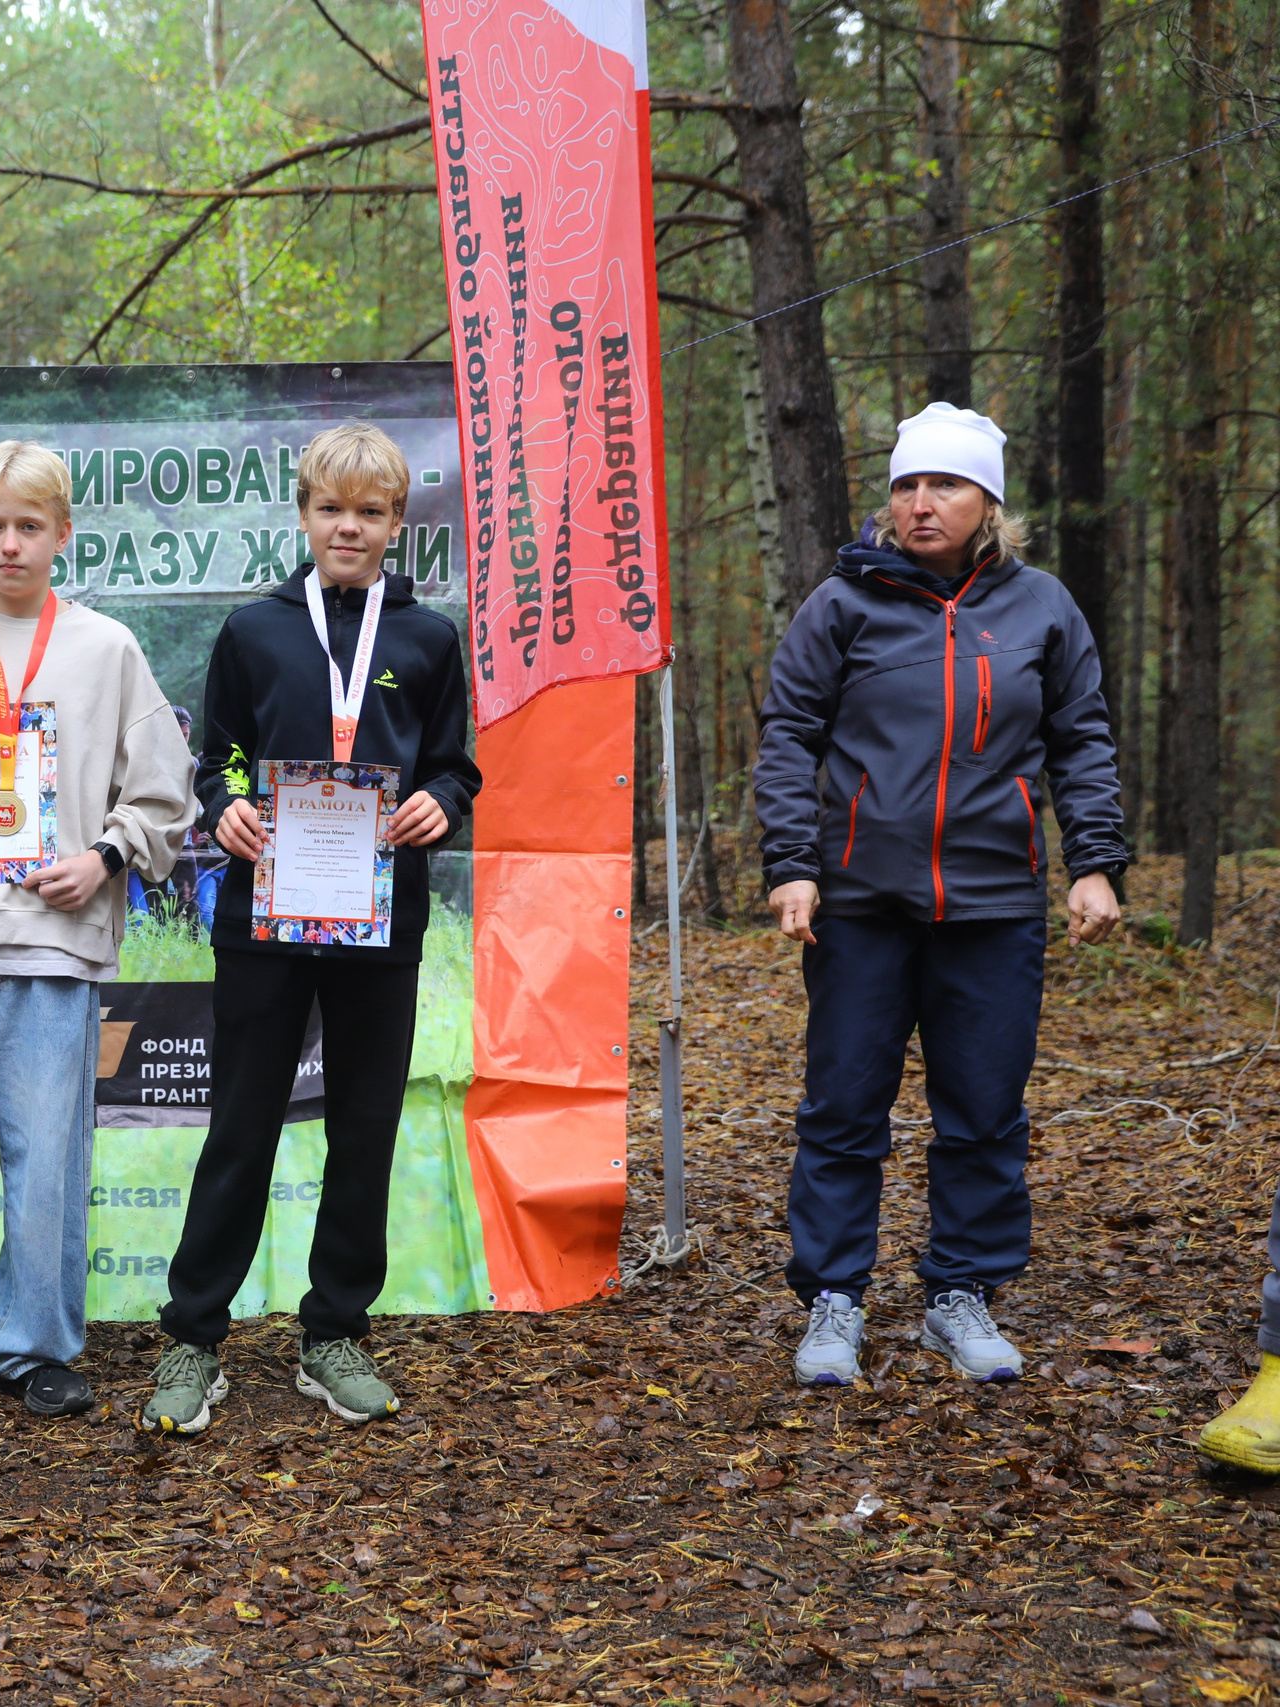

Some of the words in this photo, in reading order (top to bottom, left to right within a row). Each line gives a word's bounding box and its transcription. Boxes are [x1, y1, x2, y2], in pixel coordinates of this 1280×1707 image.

[50, 529, 220, 589] РАЗУ
[241, 525, 451, 584] ЖНИ
[360, 591, 379, 656] ЧЕЛЯБИНСКАЯ
[351, 656, 366, 700] ОБЛАСТЬ
[287, 797, 367, 812] ГРАМОТА
[141, 1038, 206, 1057] ФОНД
[141, 1087, 211, 1104] ГРАНТ
